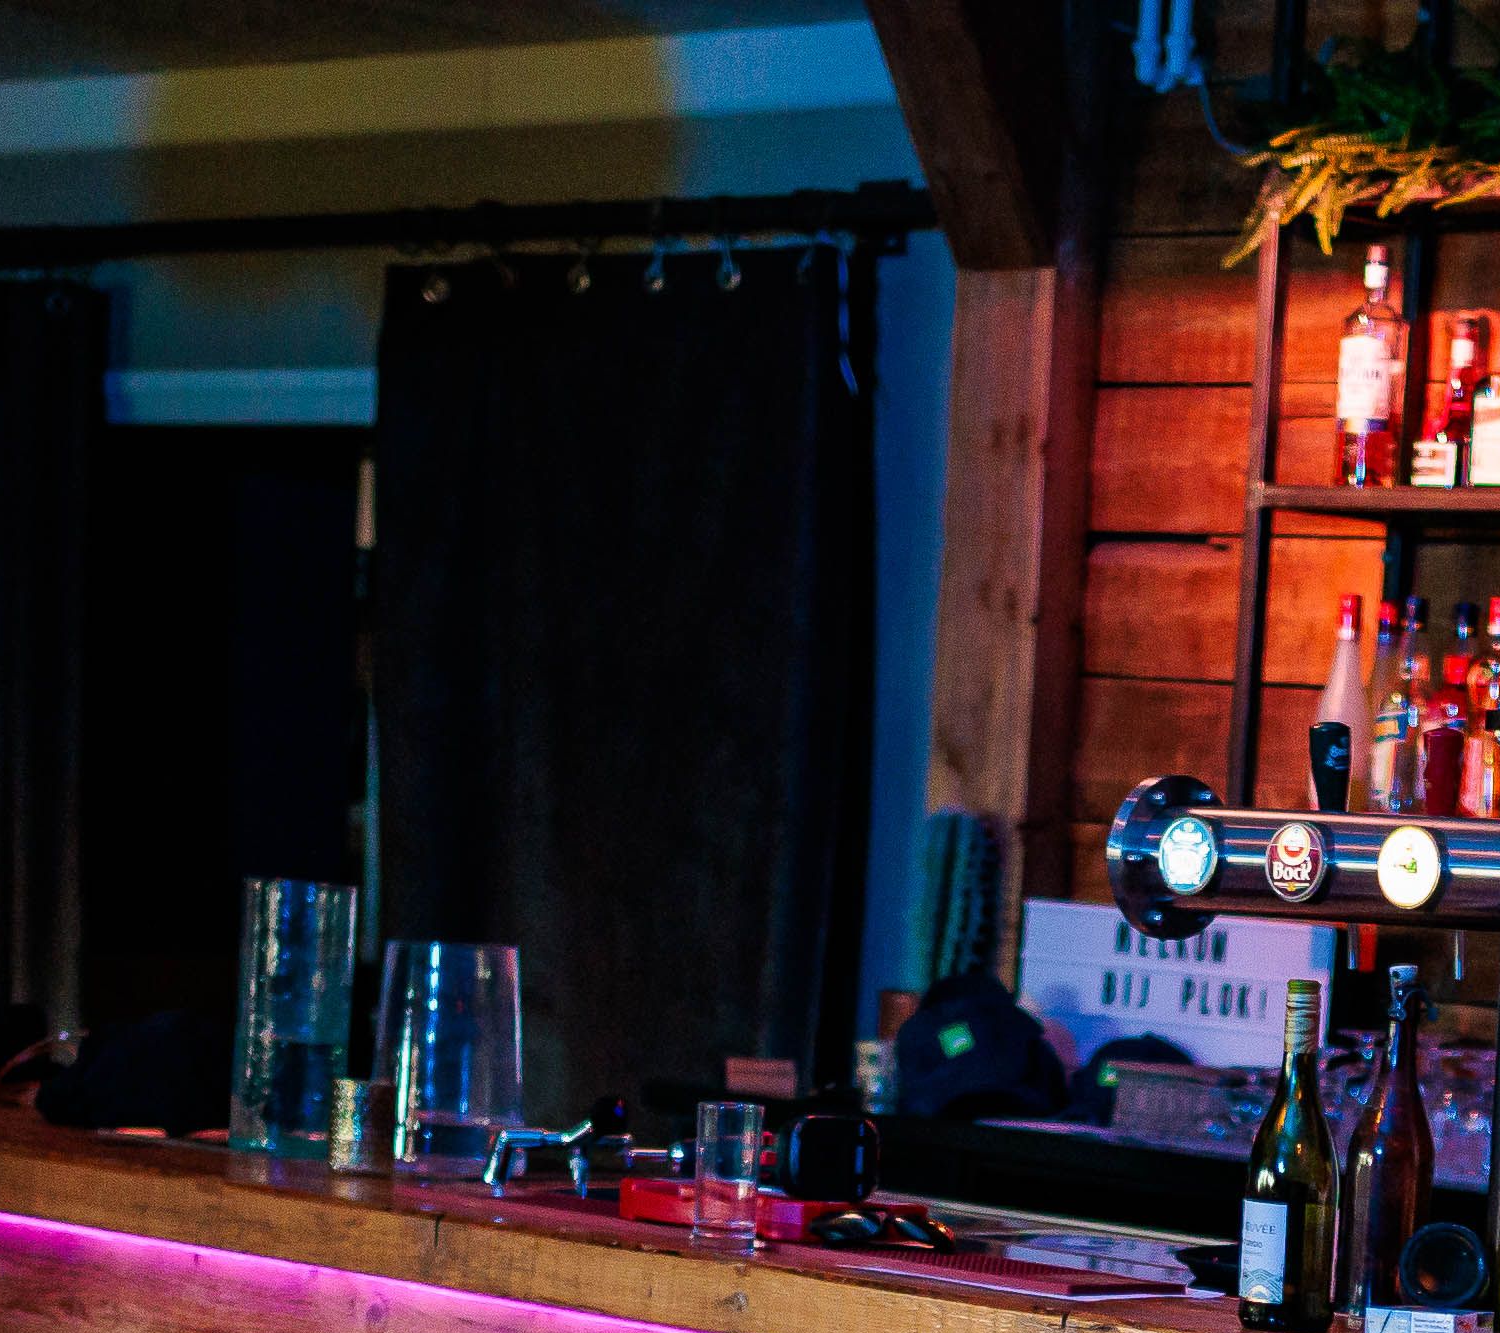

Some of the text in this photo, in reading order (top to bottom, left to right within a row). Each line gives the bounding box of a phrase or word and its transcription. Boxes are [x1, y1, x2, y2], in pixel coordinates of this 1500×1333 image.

[1272, 857, 1311, 881] Bock
[1101, 970, 1268, 1019] BIJ PLOK!
